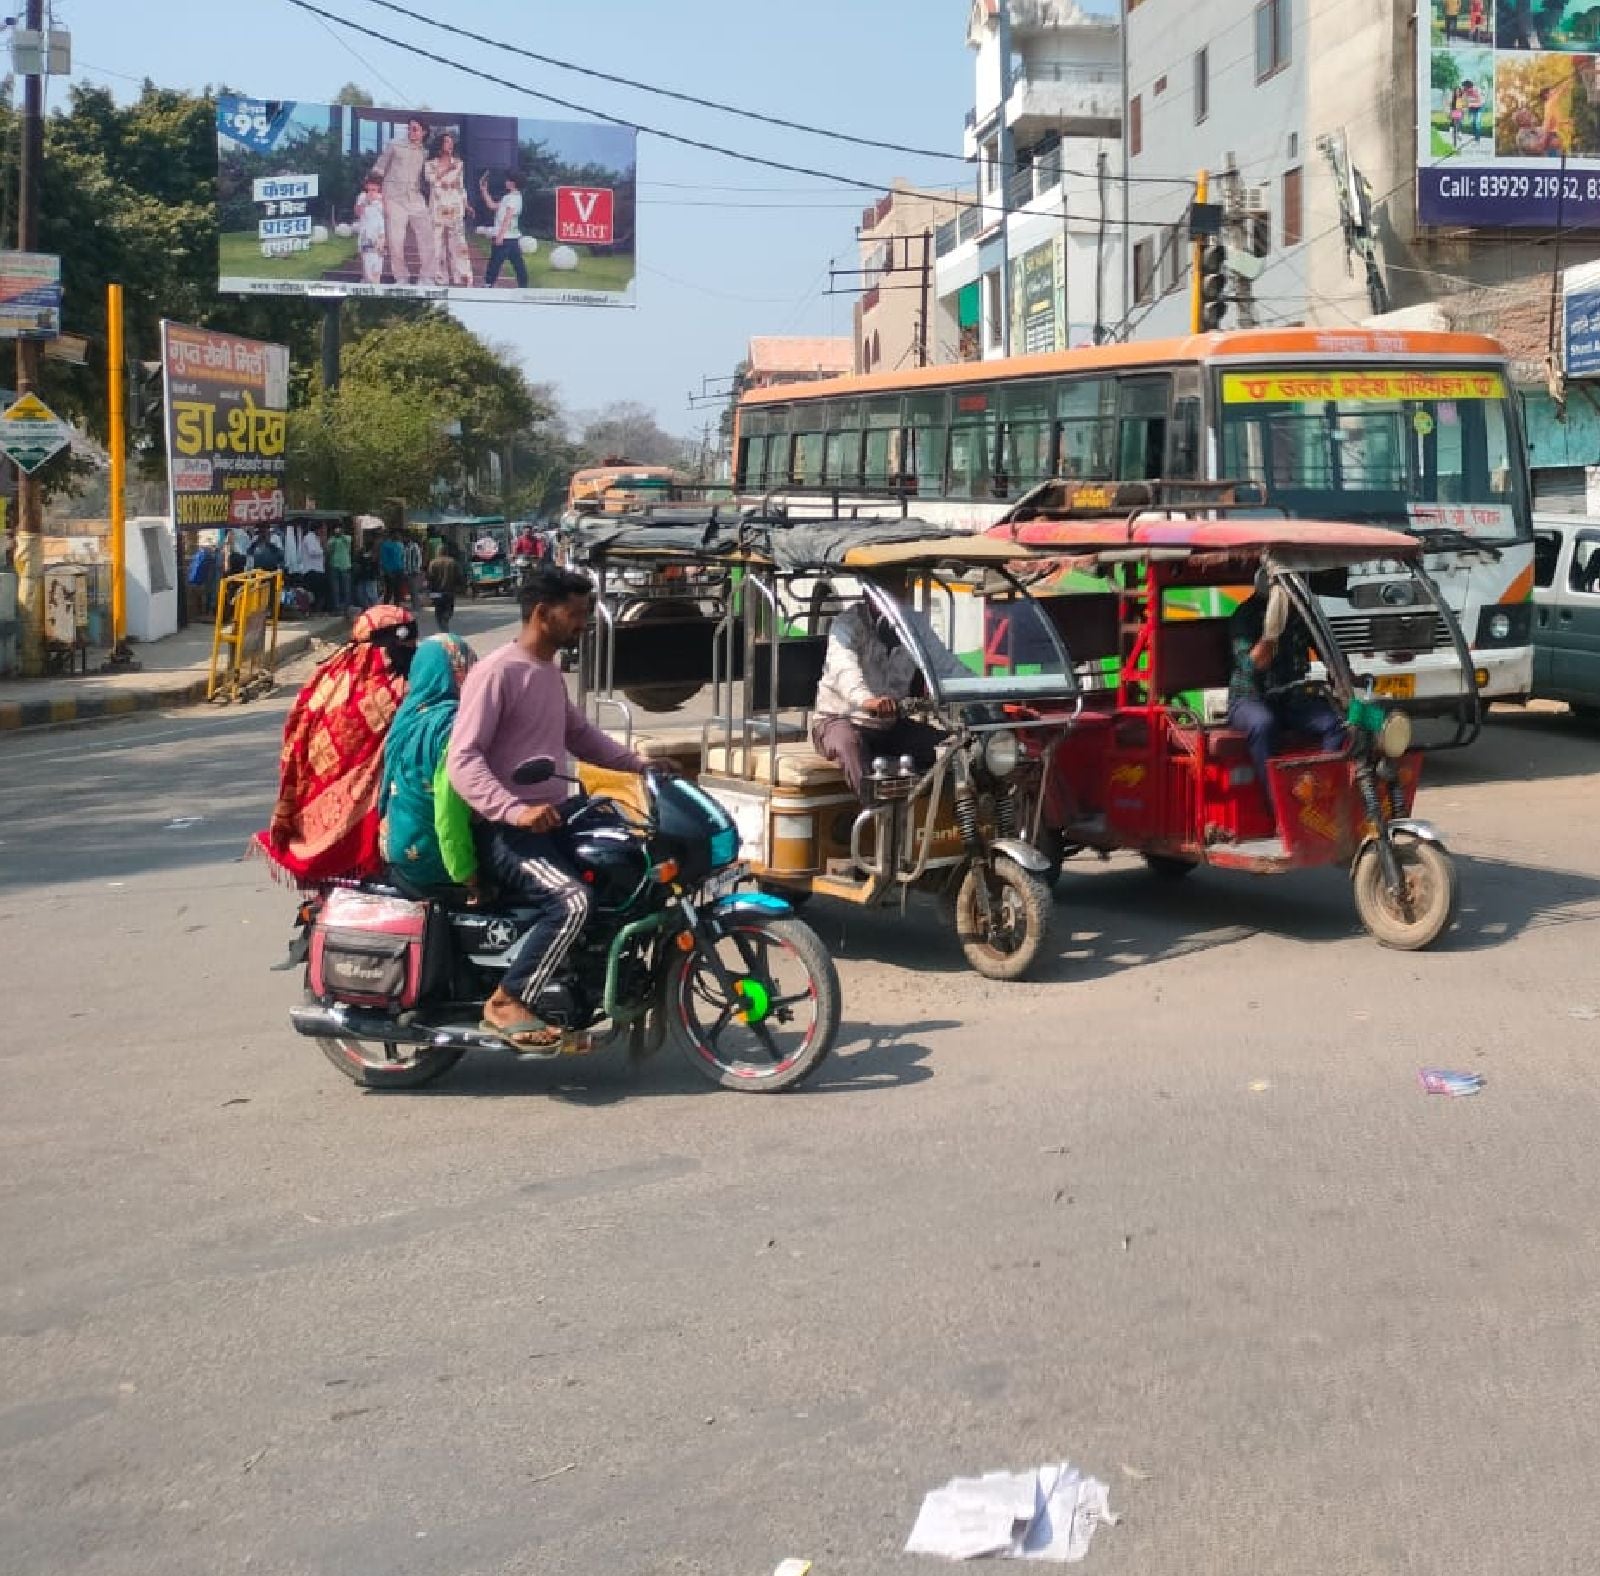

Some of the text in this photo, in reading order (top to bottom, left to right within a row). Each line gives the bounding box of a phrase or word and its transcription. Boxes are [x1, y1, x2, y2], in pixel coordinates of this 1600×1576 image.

[1439, 176, 1476, 197] Call:
[1479, 176, 1529, 197] 83929
[569, 191, 600, 222] V
[561, 222, 608, 239] MART
